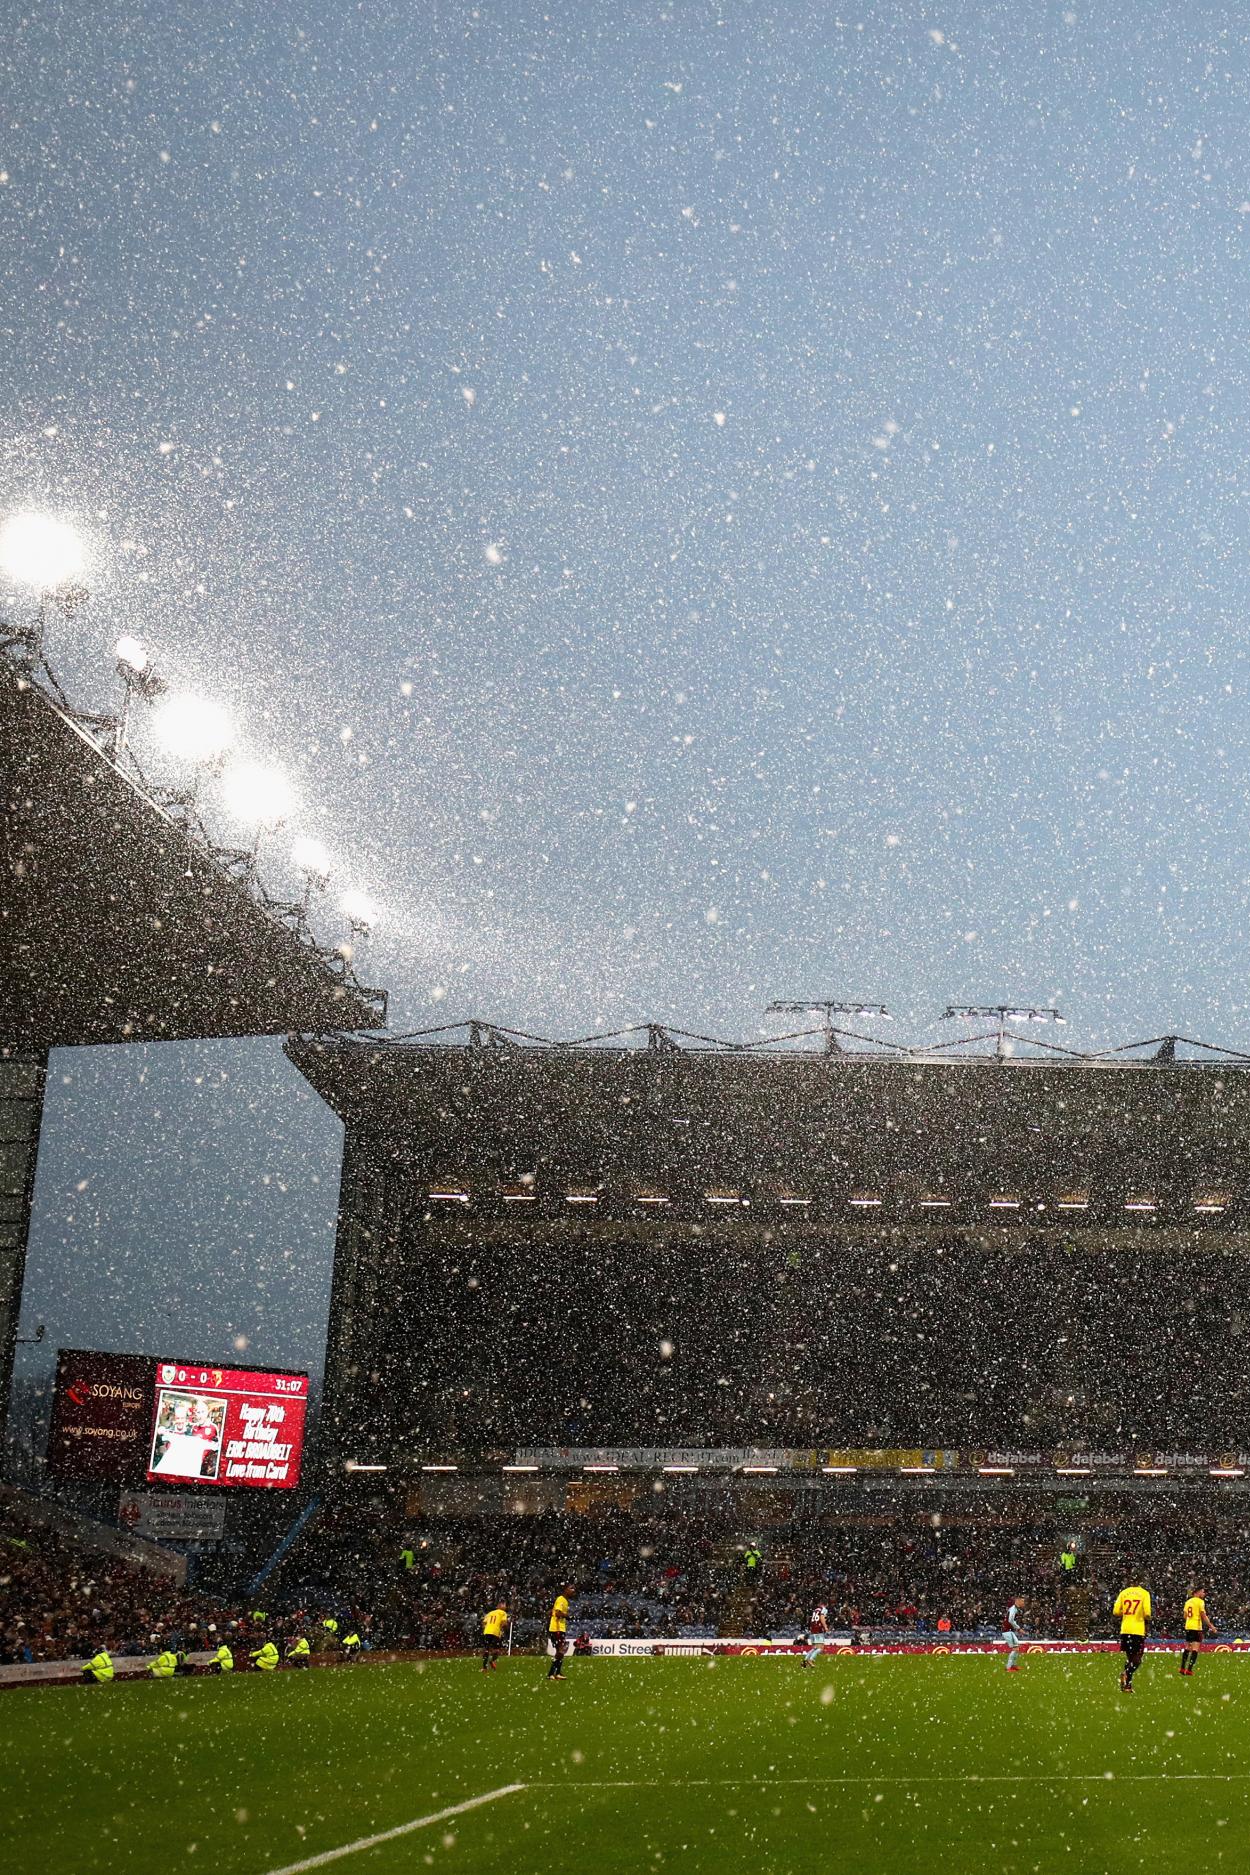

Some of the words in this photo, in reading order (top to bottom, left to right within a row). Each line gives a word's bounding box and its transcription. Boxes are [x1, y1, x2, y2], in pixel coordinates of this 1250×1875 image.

[178, 1370, 186, 1382] 0
[200, 1372, 207, 1383] 0
[92, 1384, 143, 1400] SOYANG
[275, 1379, 302, 1392] 31:07
[988, 1451, 1042, 1466] dafabet
[1071, 1452, 1125, 1466] dafabet
[1154, 1452, 1209, 1467] dafabet
[225, 1460, 247, 1477] Love
[1123, 1599, 1141, 1616] 27
[1187, 1606, 1193, 1618] 8
